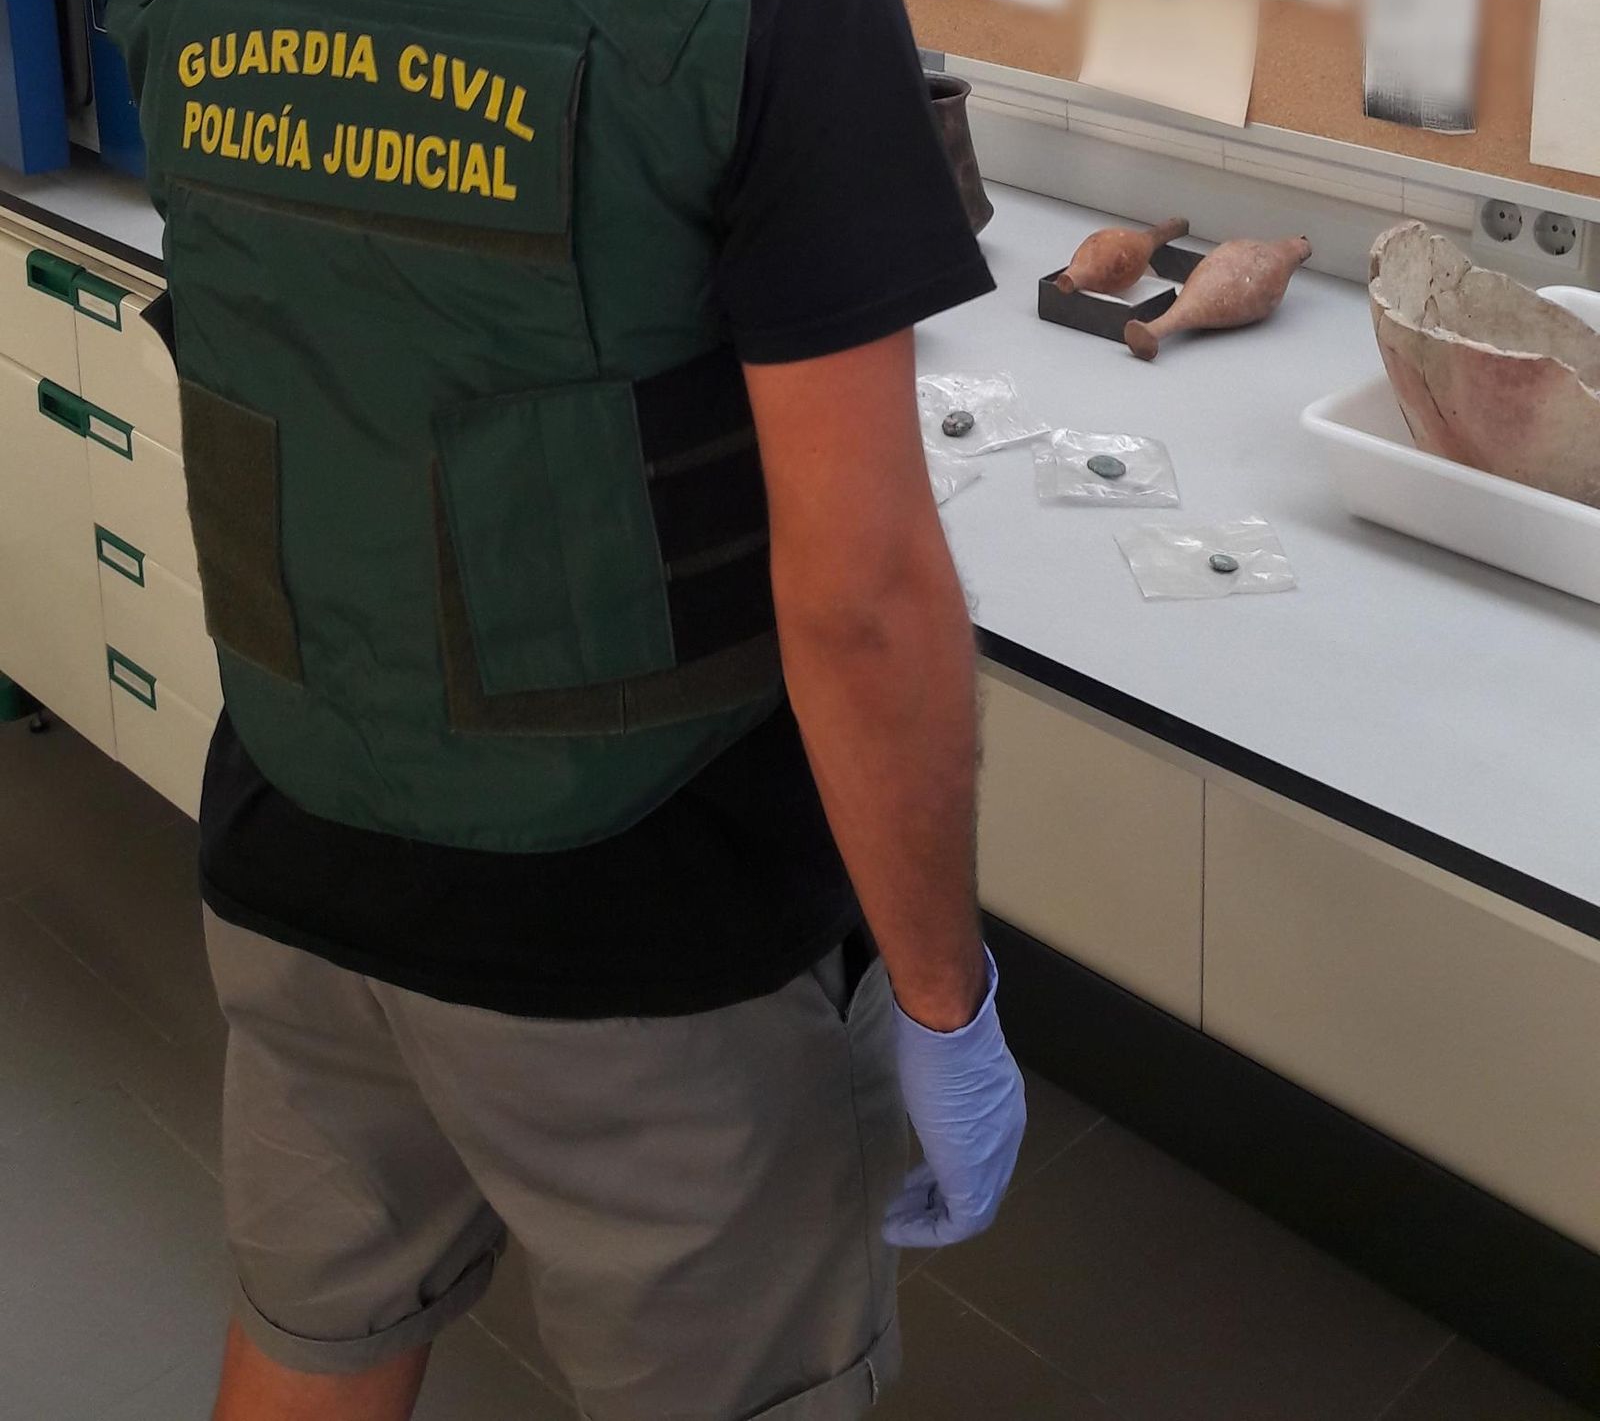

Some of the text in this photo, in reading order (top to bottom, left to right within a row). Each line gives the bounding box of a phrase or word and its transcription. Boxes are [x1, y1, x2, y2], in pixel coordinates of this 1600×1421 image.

[178, 29, 535, 142] GUARDIA CIVIL
[182, 100, 518, 202] POLICÍA JUDICIAL
